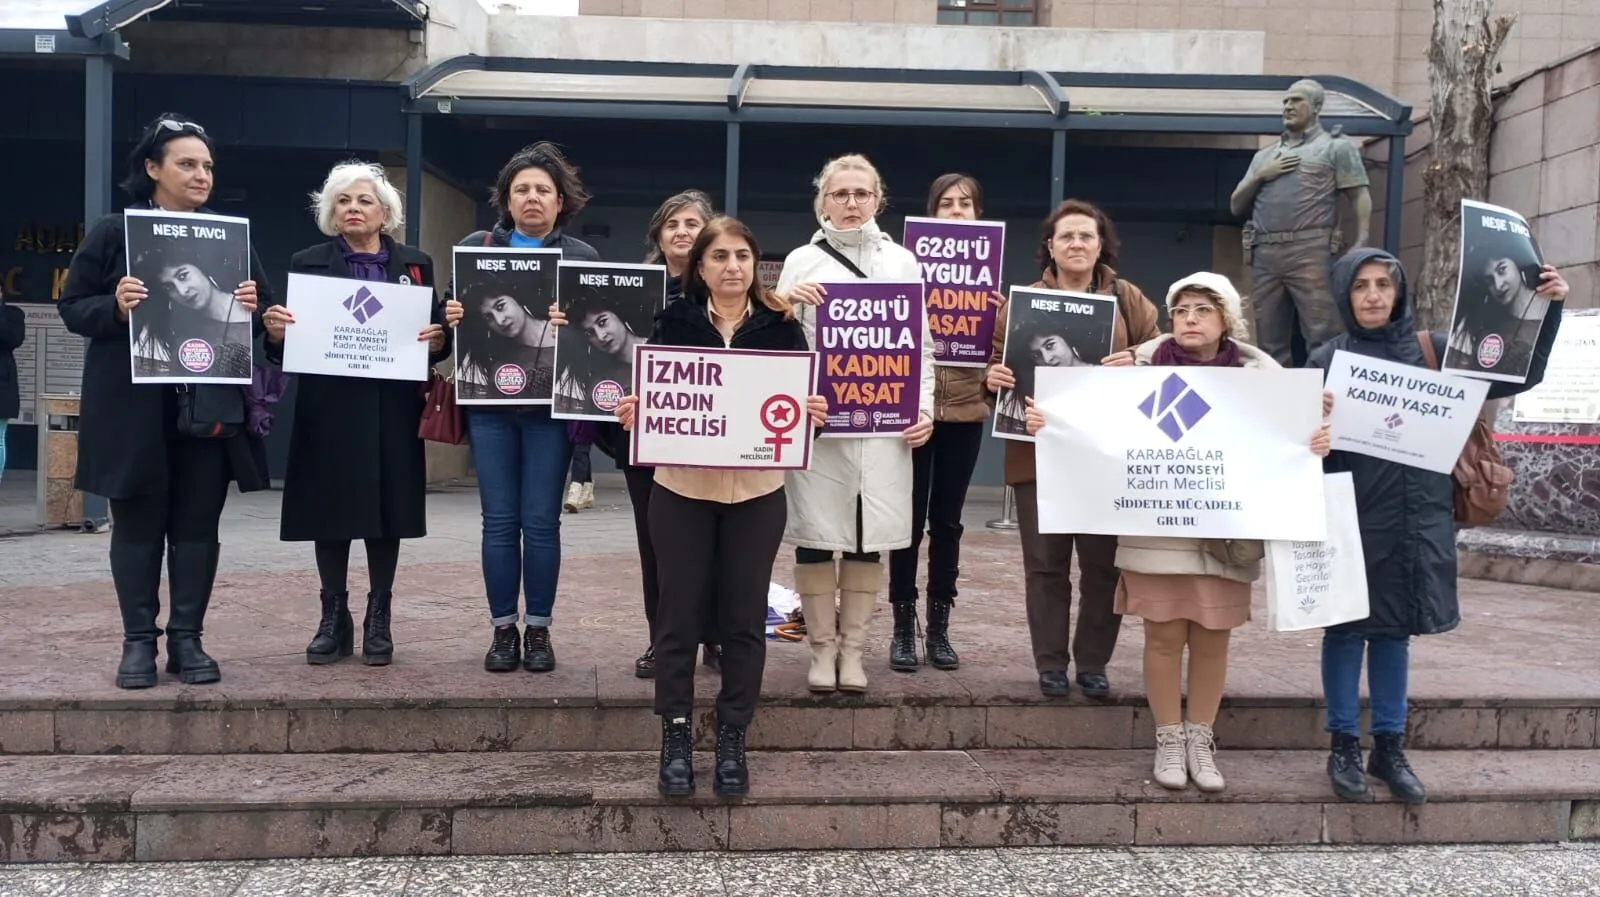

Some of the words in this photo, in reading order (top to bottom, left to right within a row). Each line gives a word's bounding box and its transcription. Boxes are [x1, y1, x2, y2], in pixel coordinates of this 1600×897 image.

[152, 223, 188, 238] NEŞE
[191, 226, 226, 240] TAVCI
[915, 236, 990, 260] 6284'Ü
[476, 259, 506, 272] NEŞE
[510, 260, 541, 271] TAVCI
[920, 262, 993, 287] YGULA
[579, 274, 609, 287] NEŞE
[612, 275, 644, 287] TAVCI
[828, 295, 910, 321] 6284'Ü
[927, 288, 988, 311] ADINI
[1031, 299, 1060, 312] NEŞE
[1063, 302, 1094, 315] TAVCI
[334, 325, 388, 337] KARABAĞLAR
[927, 313, 982, 337] AŞAT
[333, 341, 357, 349] Kadın
[358, 343, 387, 352] Meclisi
[355, 336, 388, 344] KONSEYİ
[822, 326, 915, 349] UYGULA
[647, 354, 723, 387] İZMİR
[826, 354, 910, 377] KADINI
[1350, 365, 1404, 388] YASAYI
[1406, 379, 1465, 401] UYGULA
[646, 390, 714, 412] KADIN
[832, 382, 905, 406] YAŞAT
[1346, 387, 1398, 407] KADINI
[1401, 398, 1453, 419] YAŞAT.
[645, 414, 727, 437] MECLİSİ
[1126, 447, 1224, 461] KARABAĞLAR
[1127, 464, 1161, 474] KENT
[1167, 463, 1225, 475] KONSEYİ
[1127, 477, 1169, 490] Kadın
[1173, 477, 1225, 490] Meclisi
[1113, 496, 1174, 511] ŞİDDETLE
[1175, 498, 1243, 511] MÜCADELE
[1156, 516, 1199, 526] GRUBU
[1296, 585, 1308, 594] Bir
